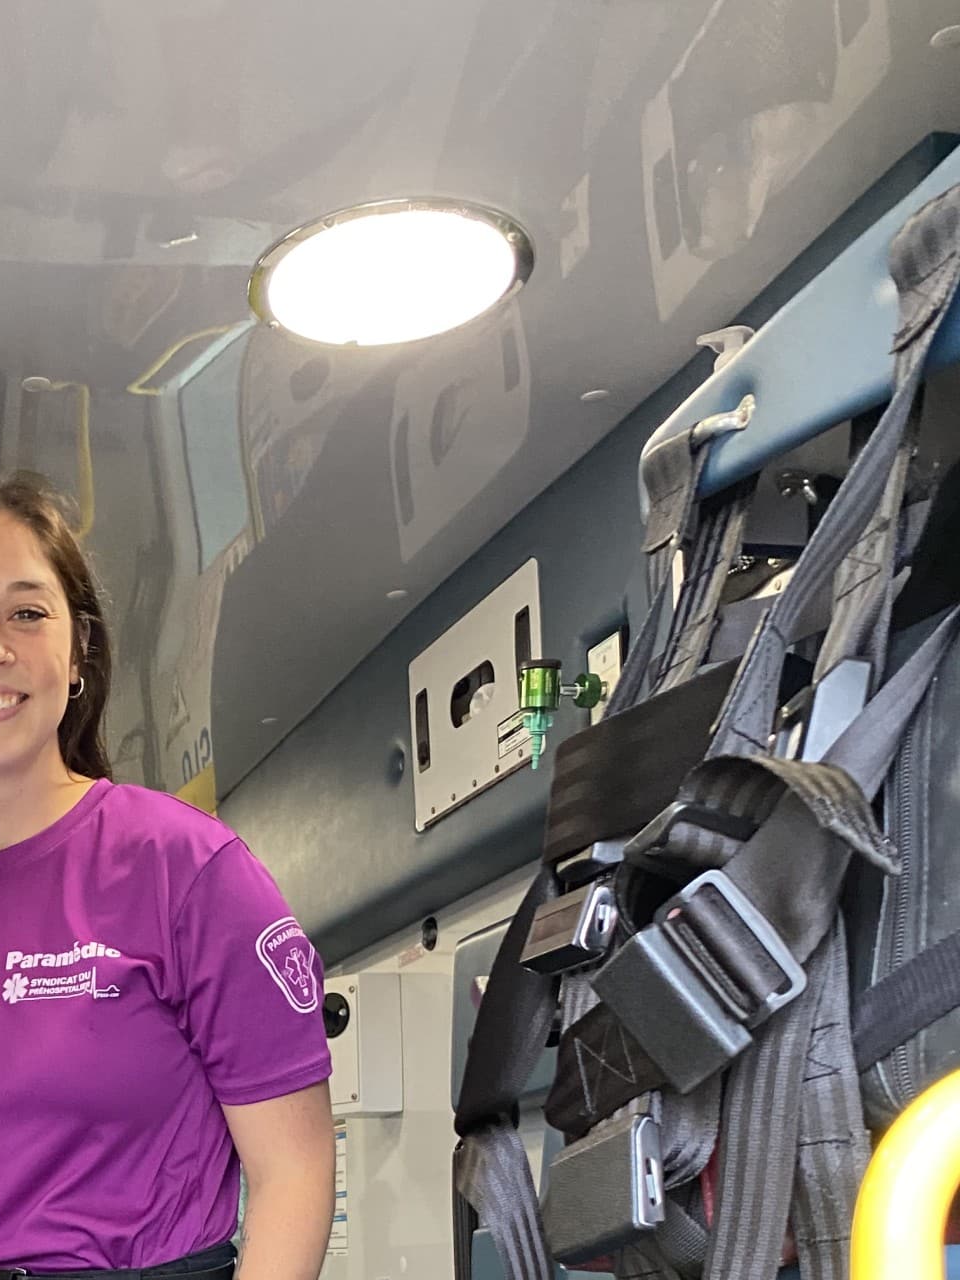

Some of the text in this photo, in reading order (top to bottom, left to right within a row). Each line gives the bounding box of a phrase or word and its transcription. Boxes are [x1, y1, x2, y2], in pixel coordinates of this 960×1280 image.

[267, 926, 306, 951] PARAMÉD
[6, 941, 121, 970] Paramédic
[31, 971, 91, 987] SYNDICAT DU
